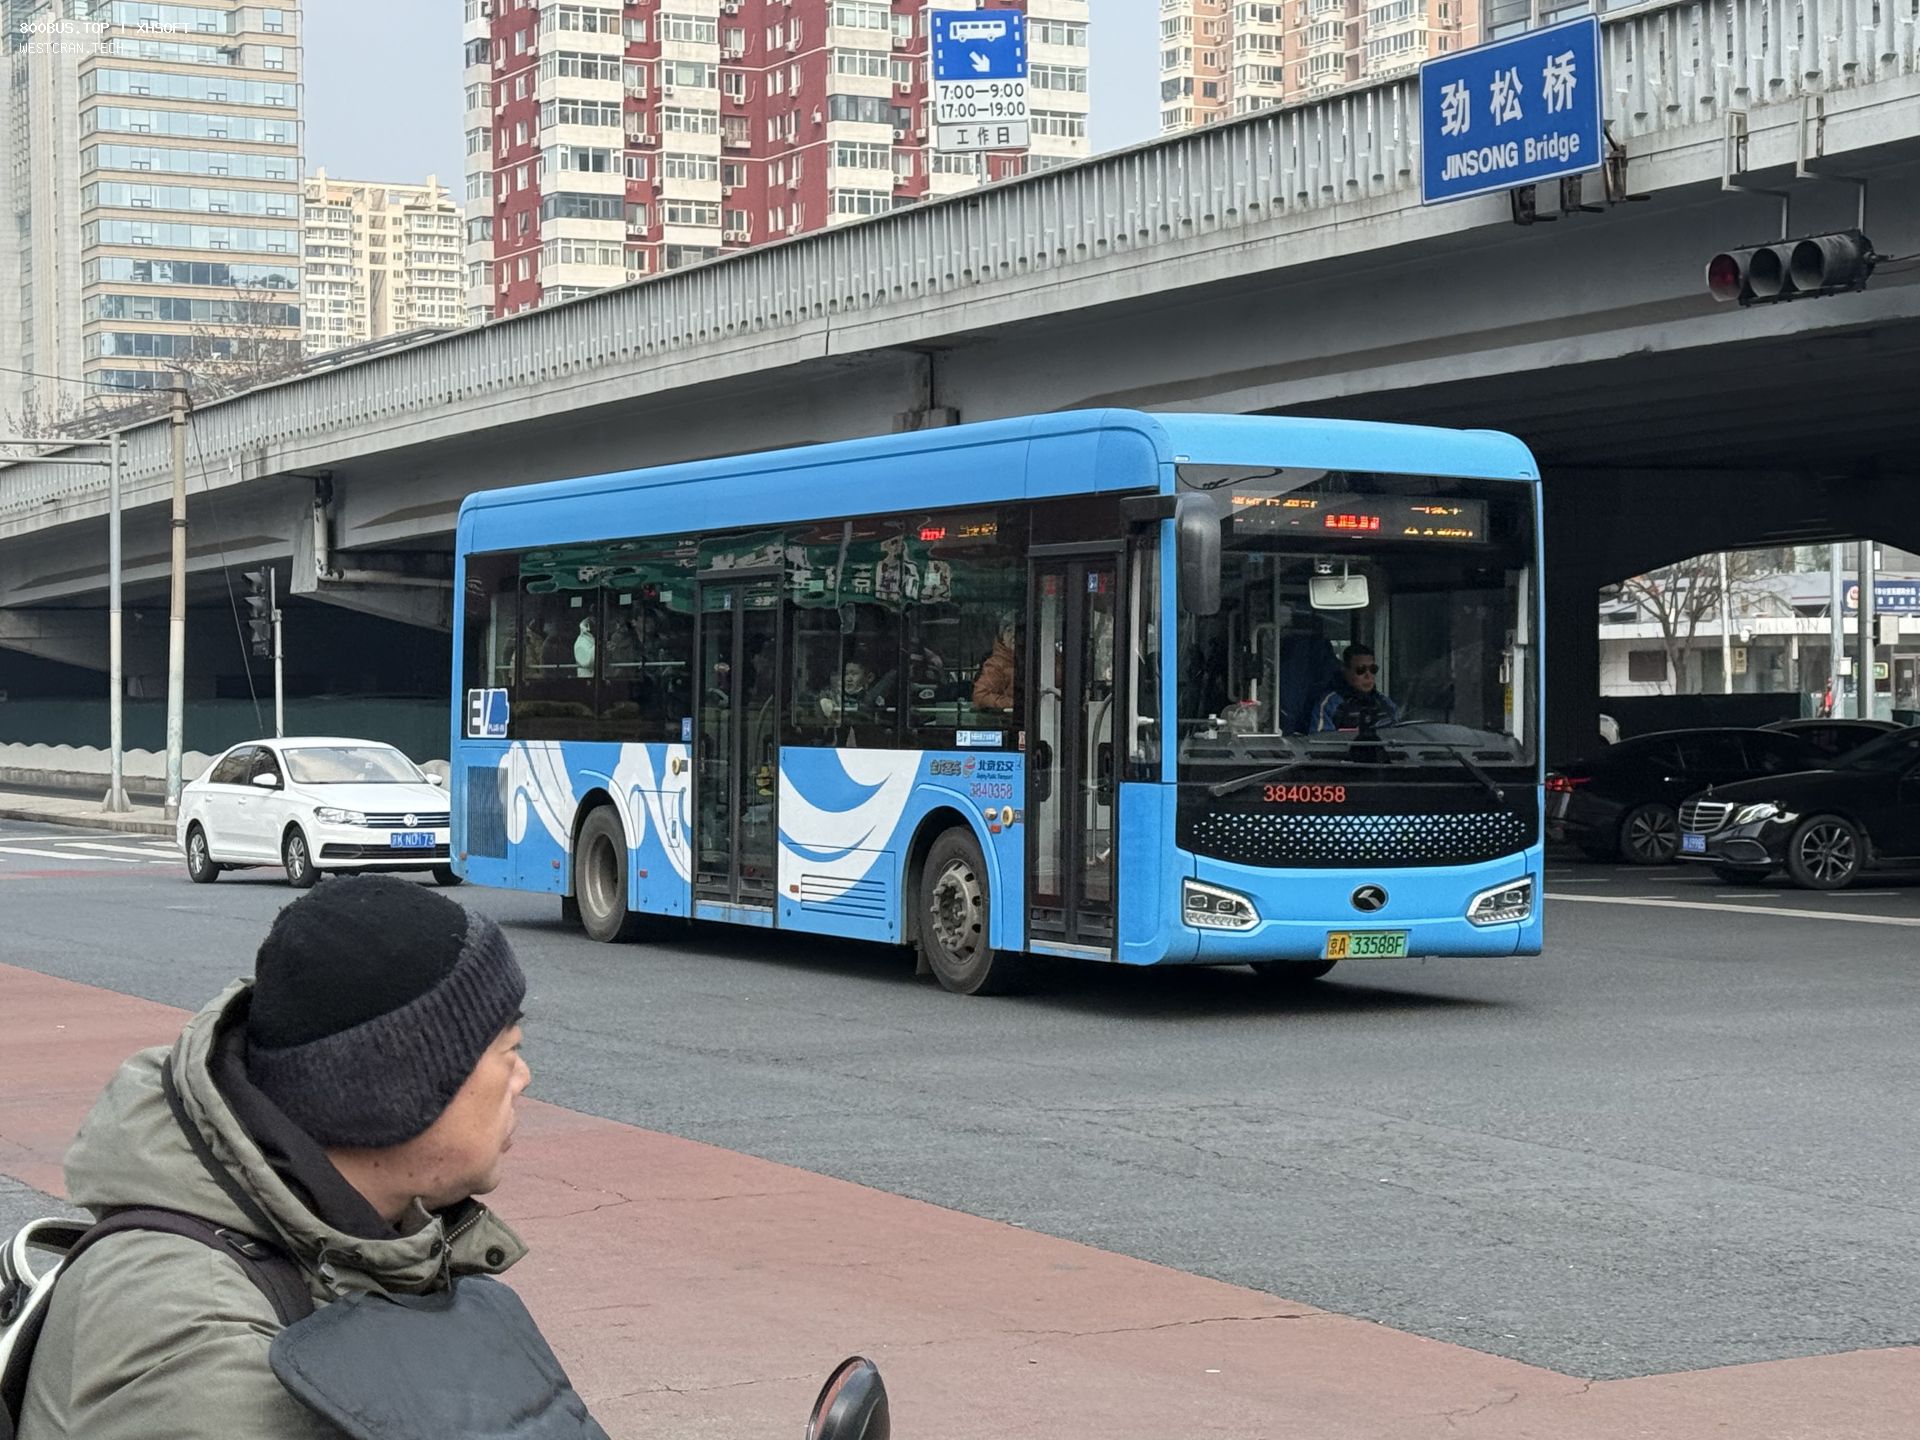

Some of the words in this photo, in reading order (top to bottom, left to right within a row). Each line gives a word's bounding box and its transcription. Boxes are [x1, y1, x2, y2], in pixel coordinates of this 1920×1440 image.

[1440, 49, 1577, 137] 劲松桥
[957, 126, 1010, 146] 工作日
[1441, 141, 1519, 181] JINSONG
[1524, 131, 1580, 163] Bridge
[977, 759, 1014, 772] 北京公交
[970, 783, 1013, 799] 3840358
[1263, 784, 1346, 803] 3840358
